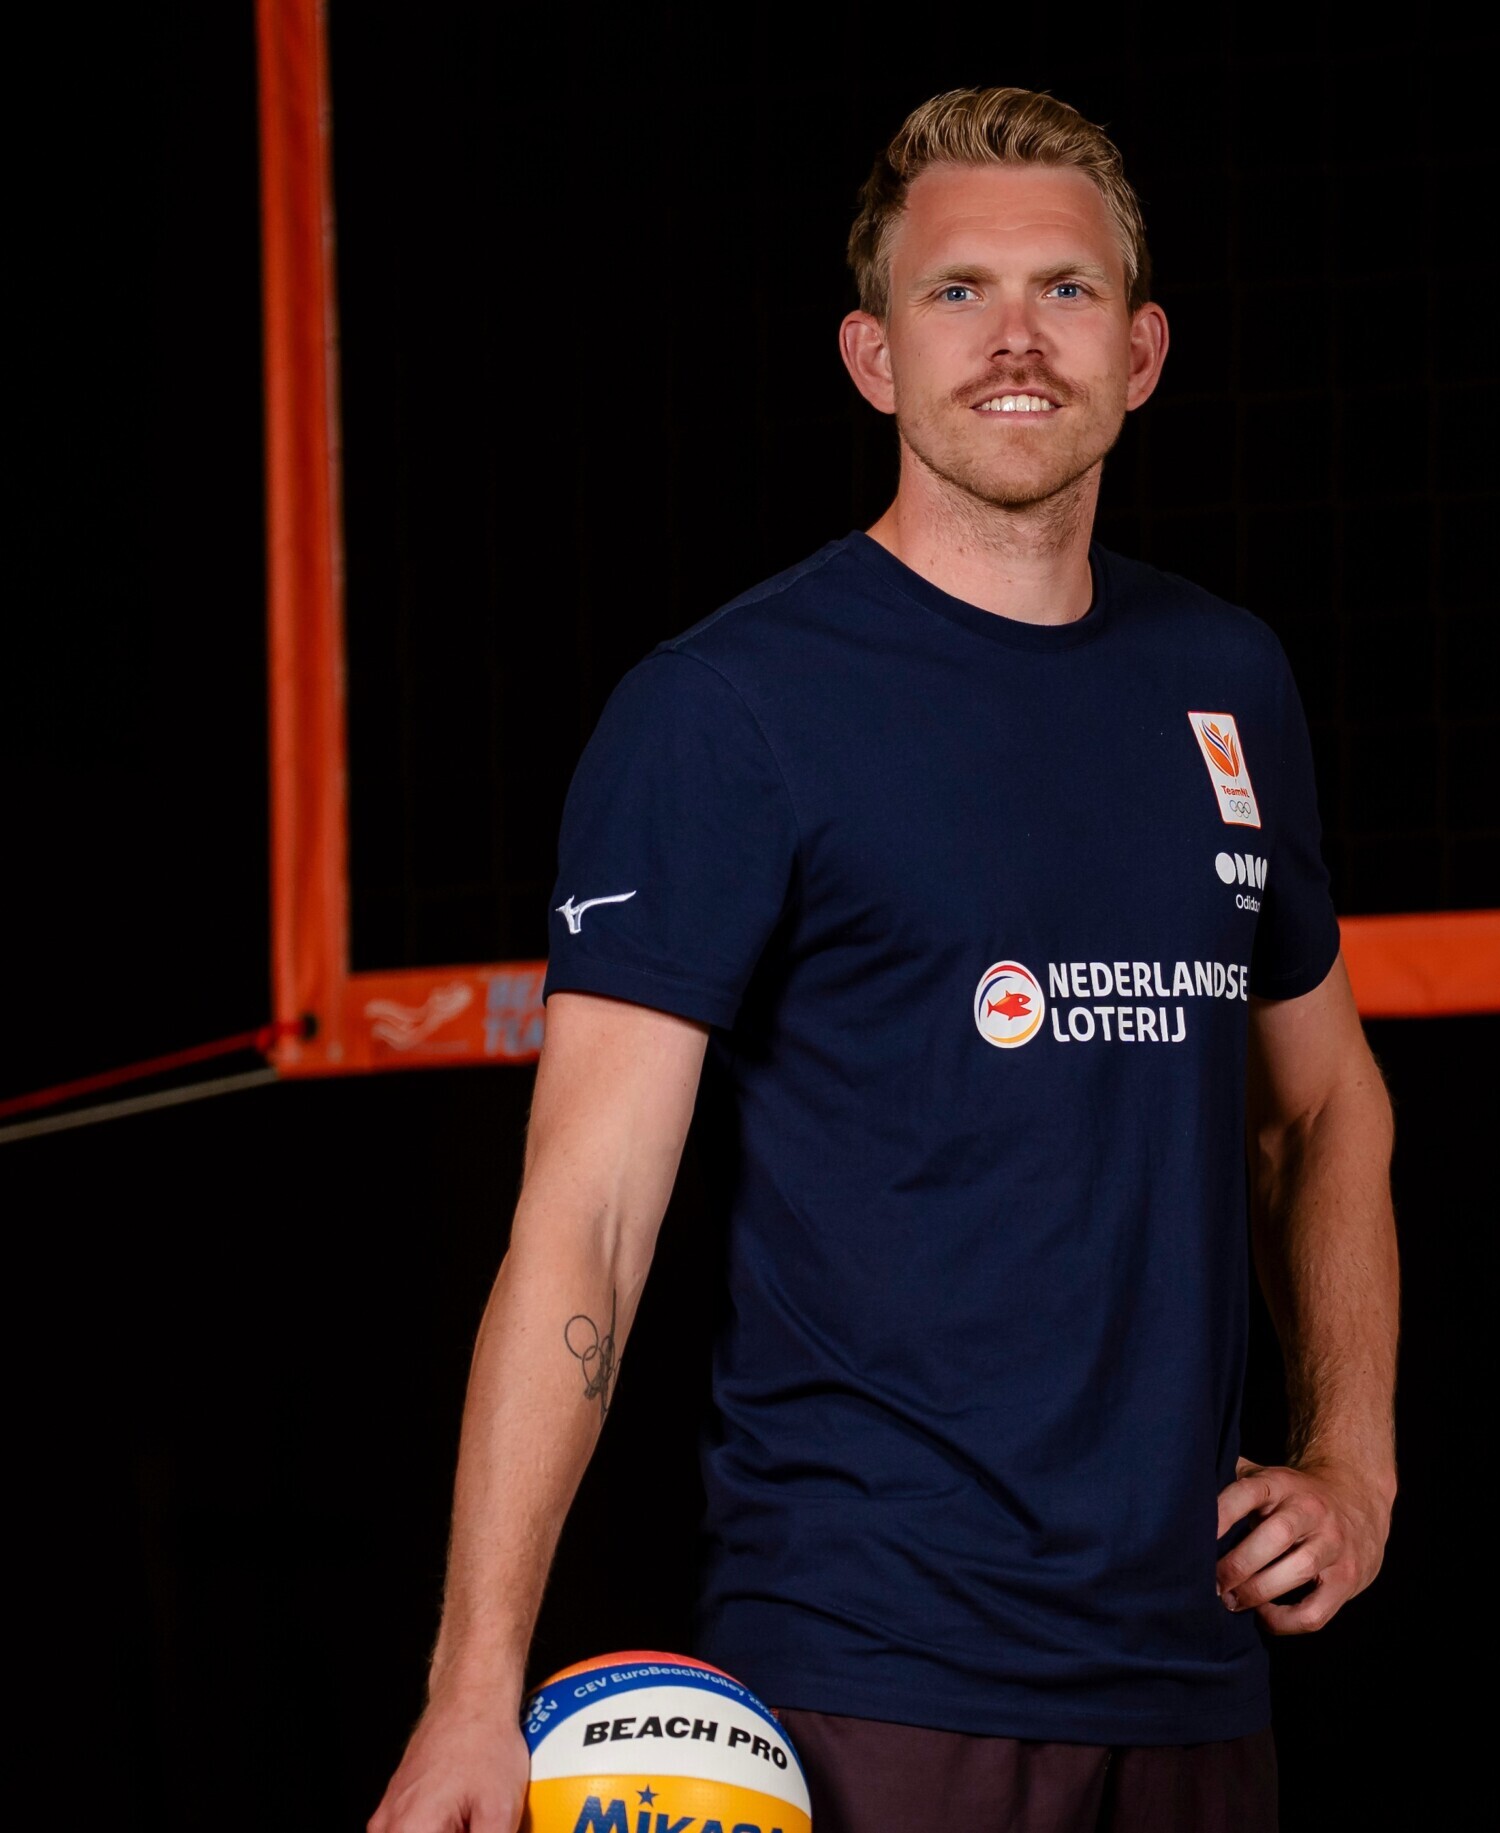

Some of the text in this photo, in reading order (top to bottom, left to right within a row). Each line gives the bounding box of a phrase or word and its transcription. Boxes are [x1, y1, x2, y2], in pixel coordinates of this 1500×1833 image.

[1221, 785, 1250, 798] TeamNL
[1048, 961, 1248, 1001] NEDERLANDSE
[1050, 1005, 1186, 1043] LOTERIJ
[573, 1677, 607, 1699] CEV
[528, 1700, 558, 1734] CEV
[582, 1716, 788, 1770] BEACH PRO
